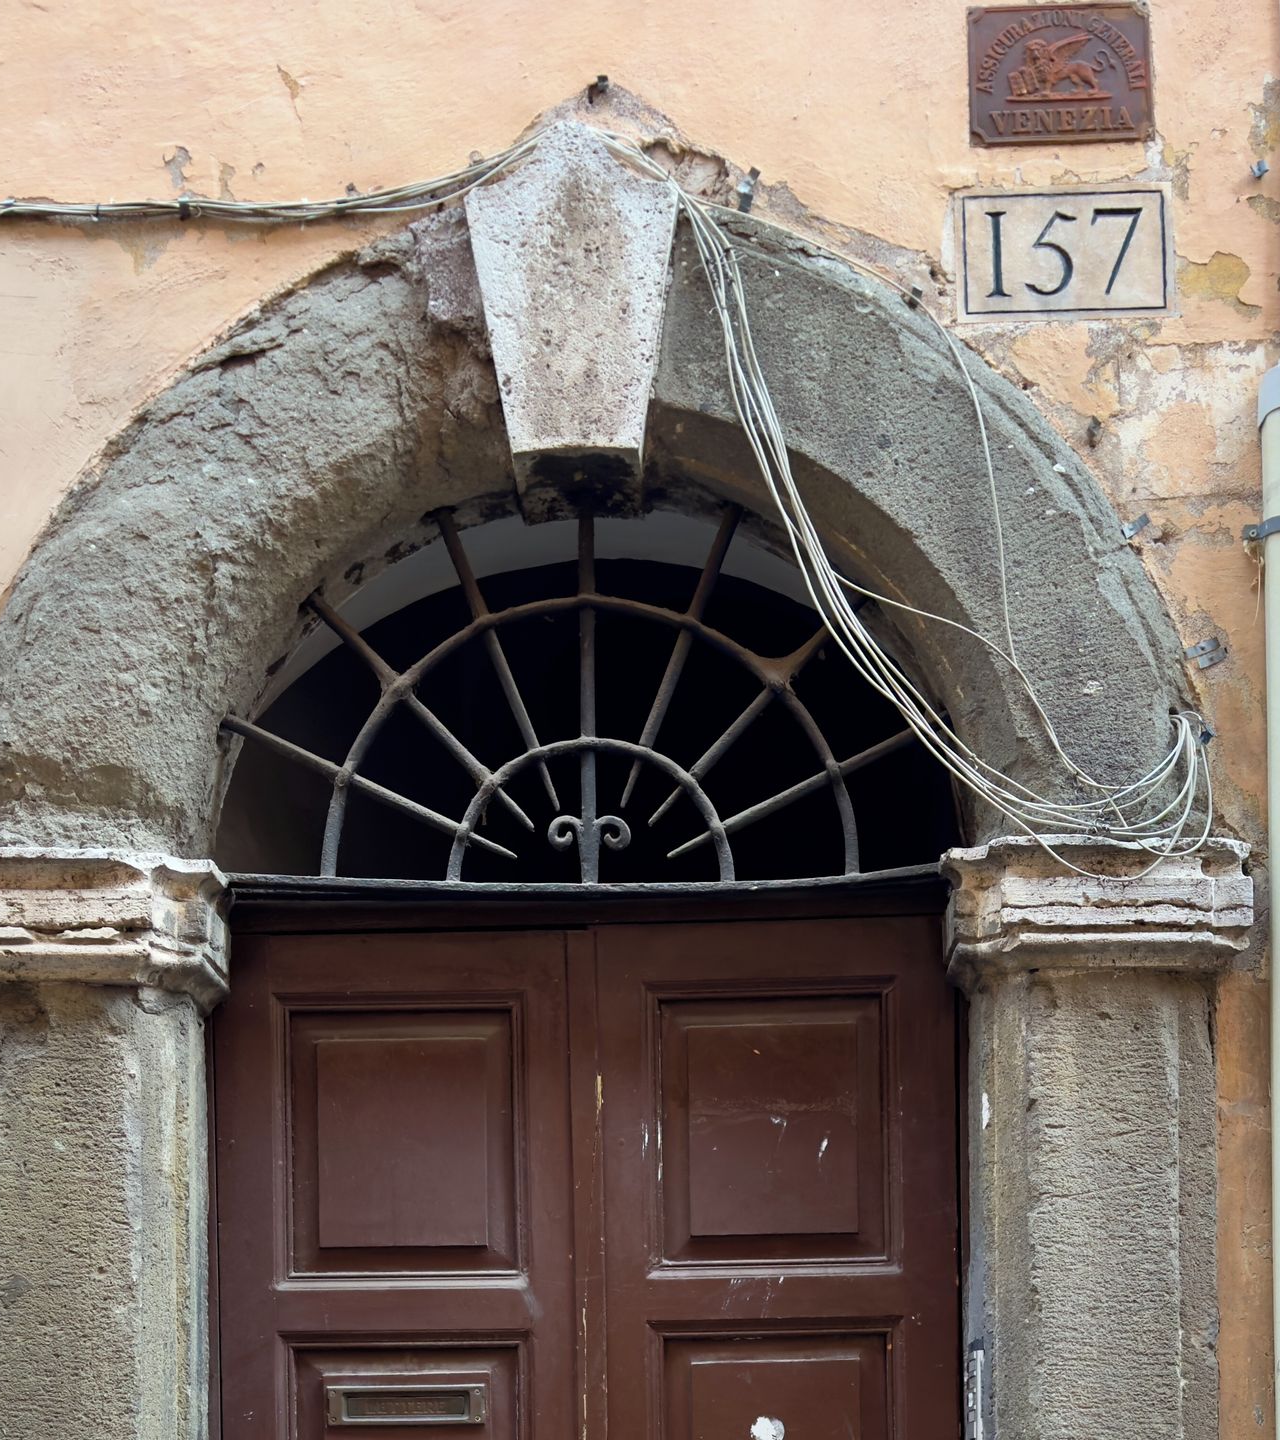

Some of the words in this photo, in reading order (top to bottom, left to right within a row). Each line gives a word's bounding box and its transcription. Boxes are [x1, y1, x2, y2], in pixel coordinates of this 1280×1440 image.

[1087, 16, 1147, 92] GENERALI
[989, 105, 1135, 135] VENEZIA
[984, 206, 1143, 298] 157
